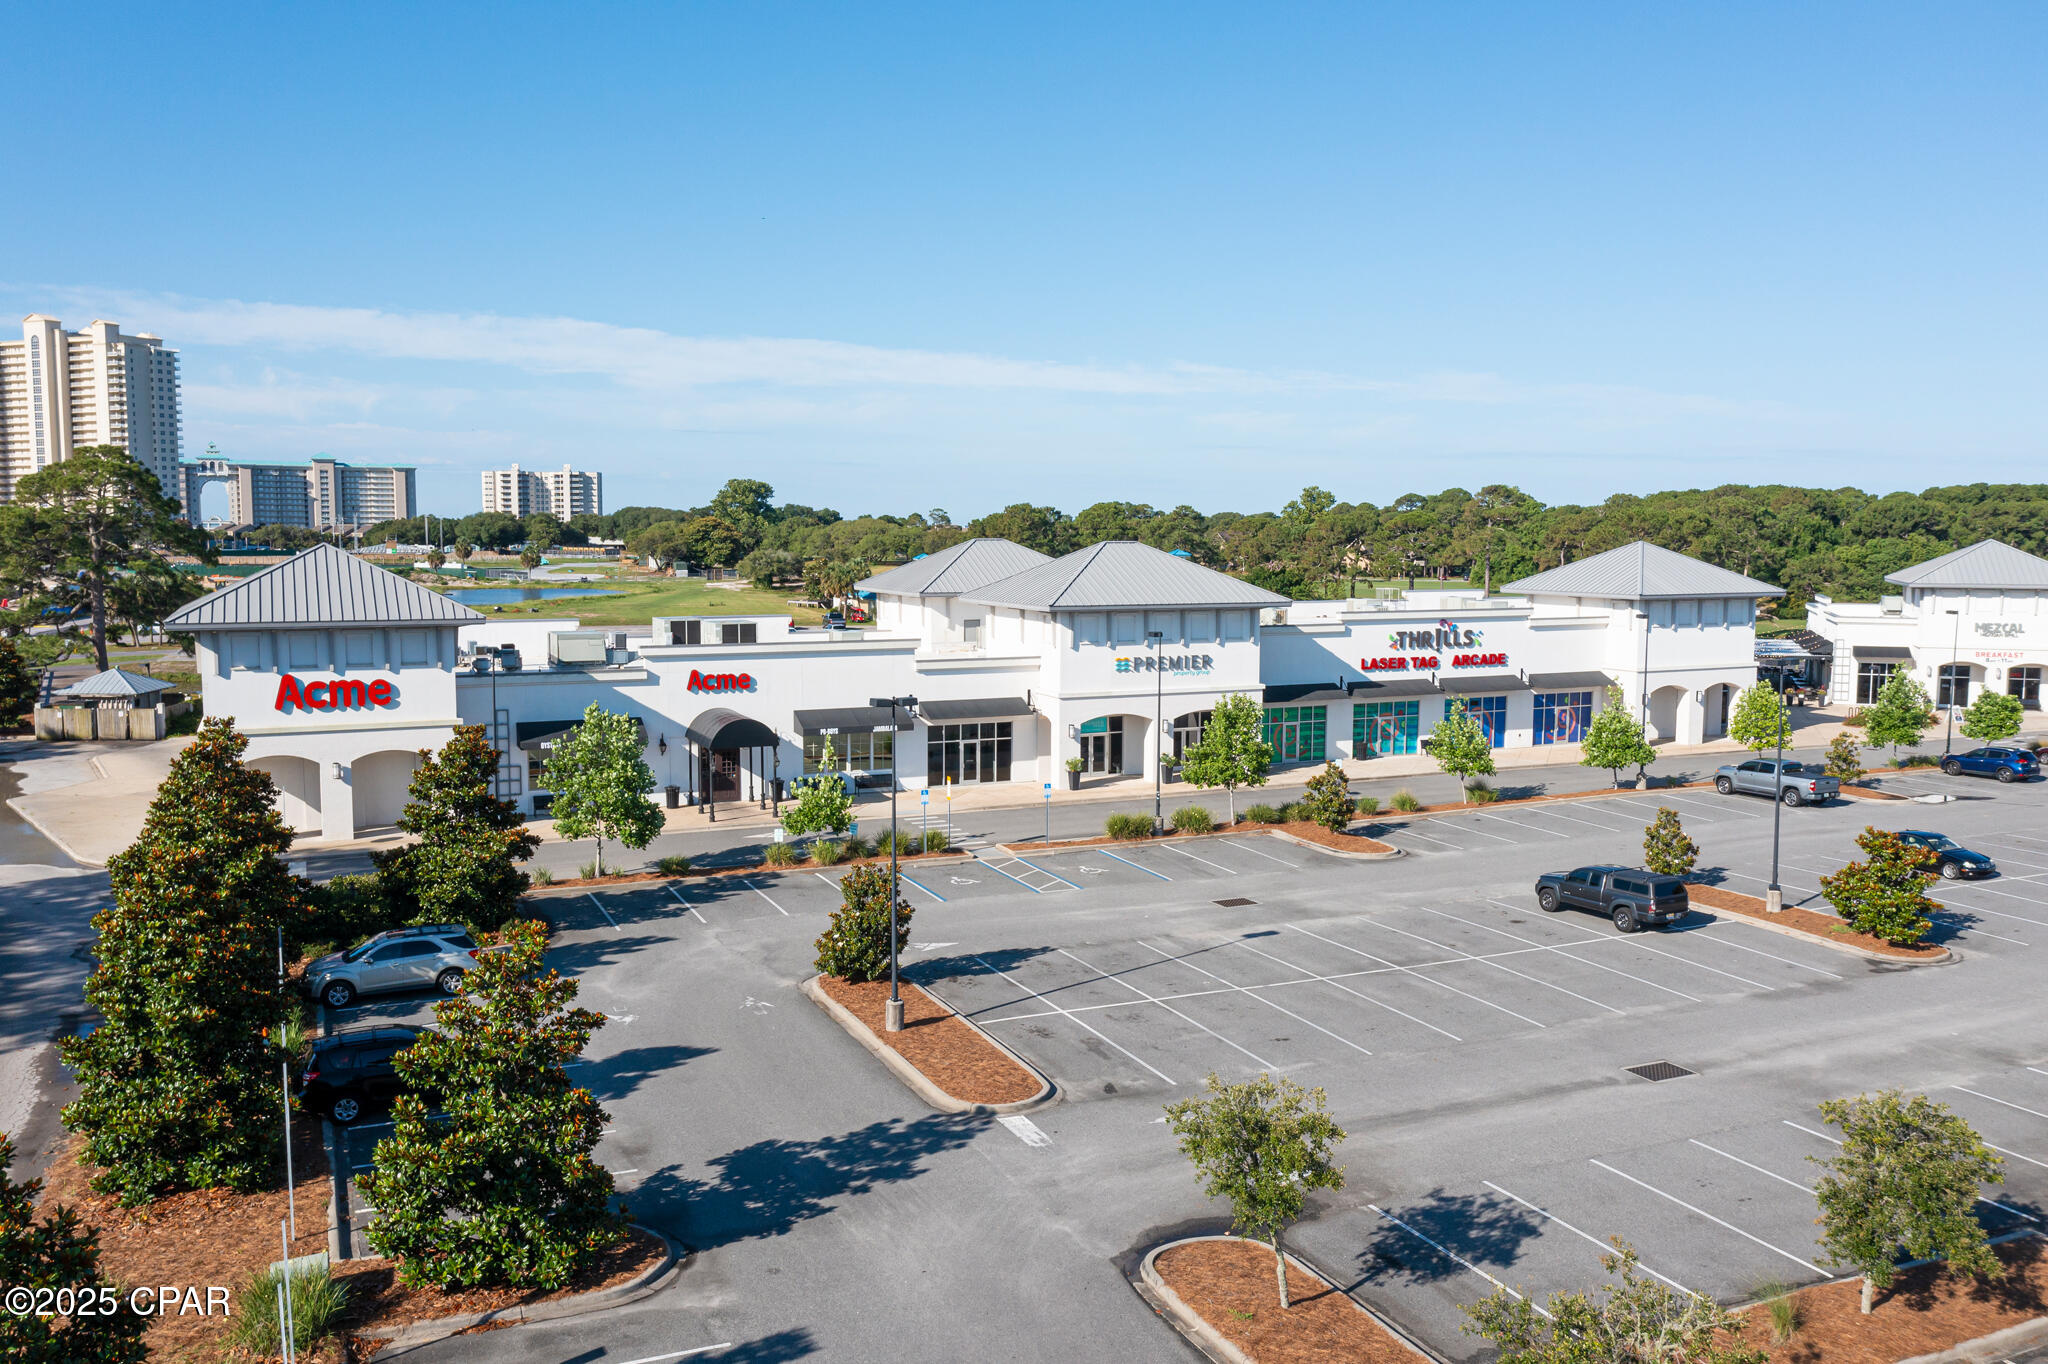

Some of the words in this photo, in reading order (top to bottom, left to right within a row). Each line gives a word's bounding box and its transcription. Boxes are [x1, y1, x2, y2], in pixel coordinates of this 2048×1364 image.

[1975, 622, 2025, 633] MEZCAL
[1133, 654, 1215, 672] PREMIER
[1361, 658, 1407, 670] LASER
[1411, 656, 1438, 669] TAG
[1452, 653, 1506, 667] ARCADE
[687, 669, 751, 691] Acme
[275, 674, 391, 711] Acme
